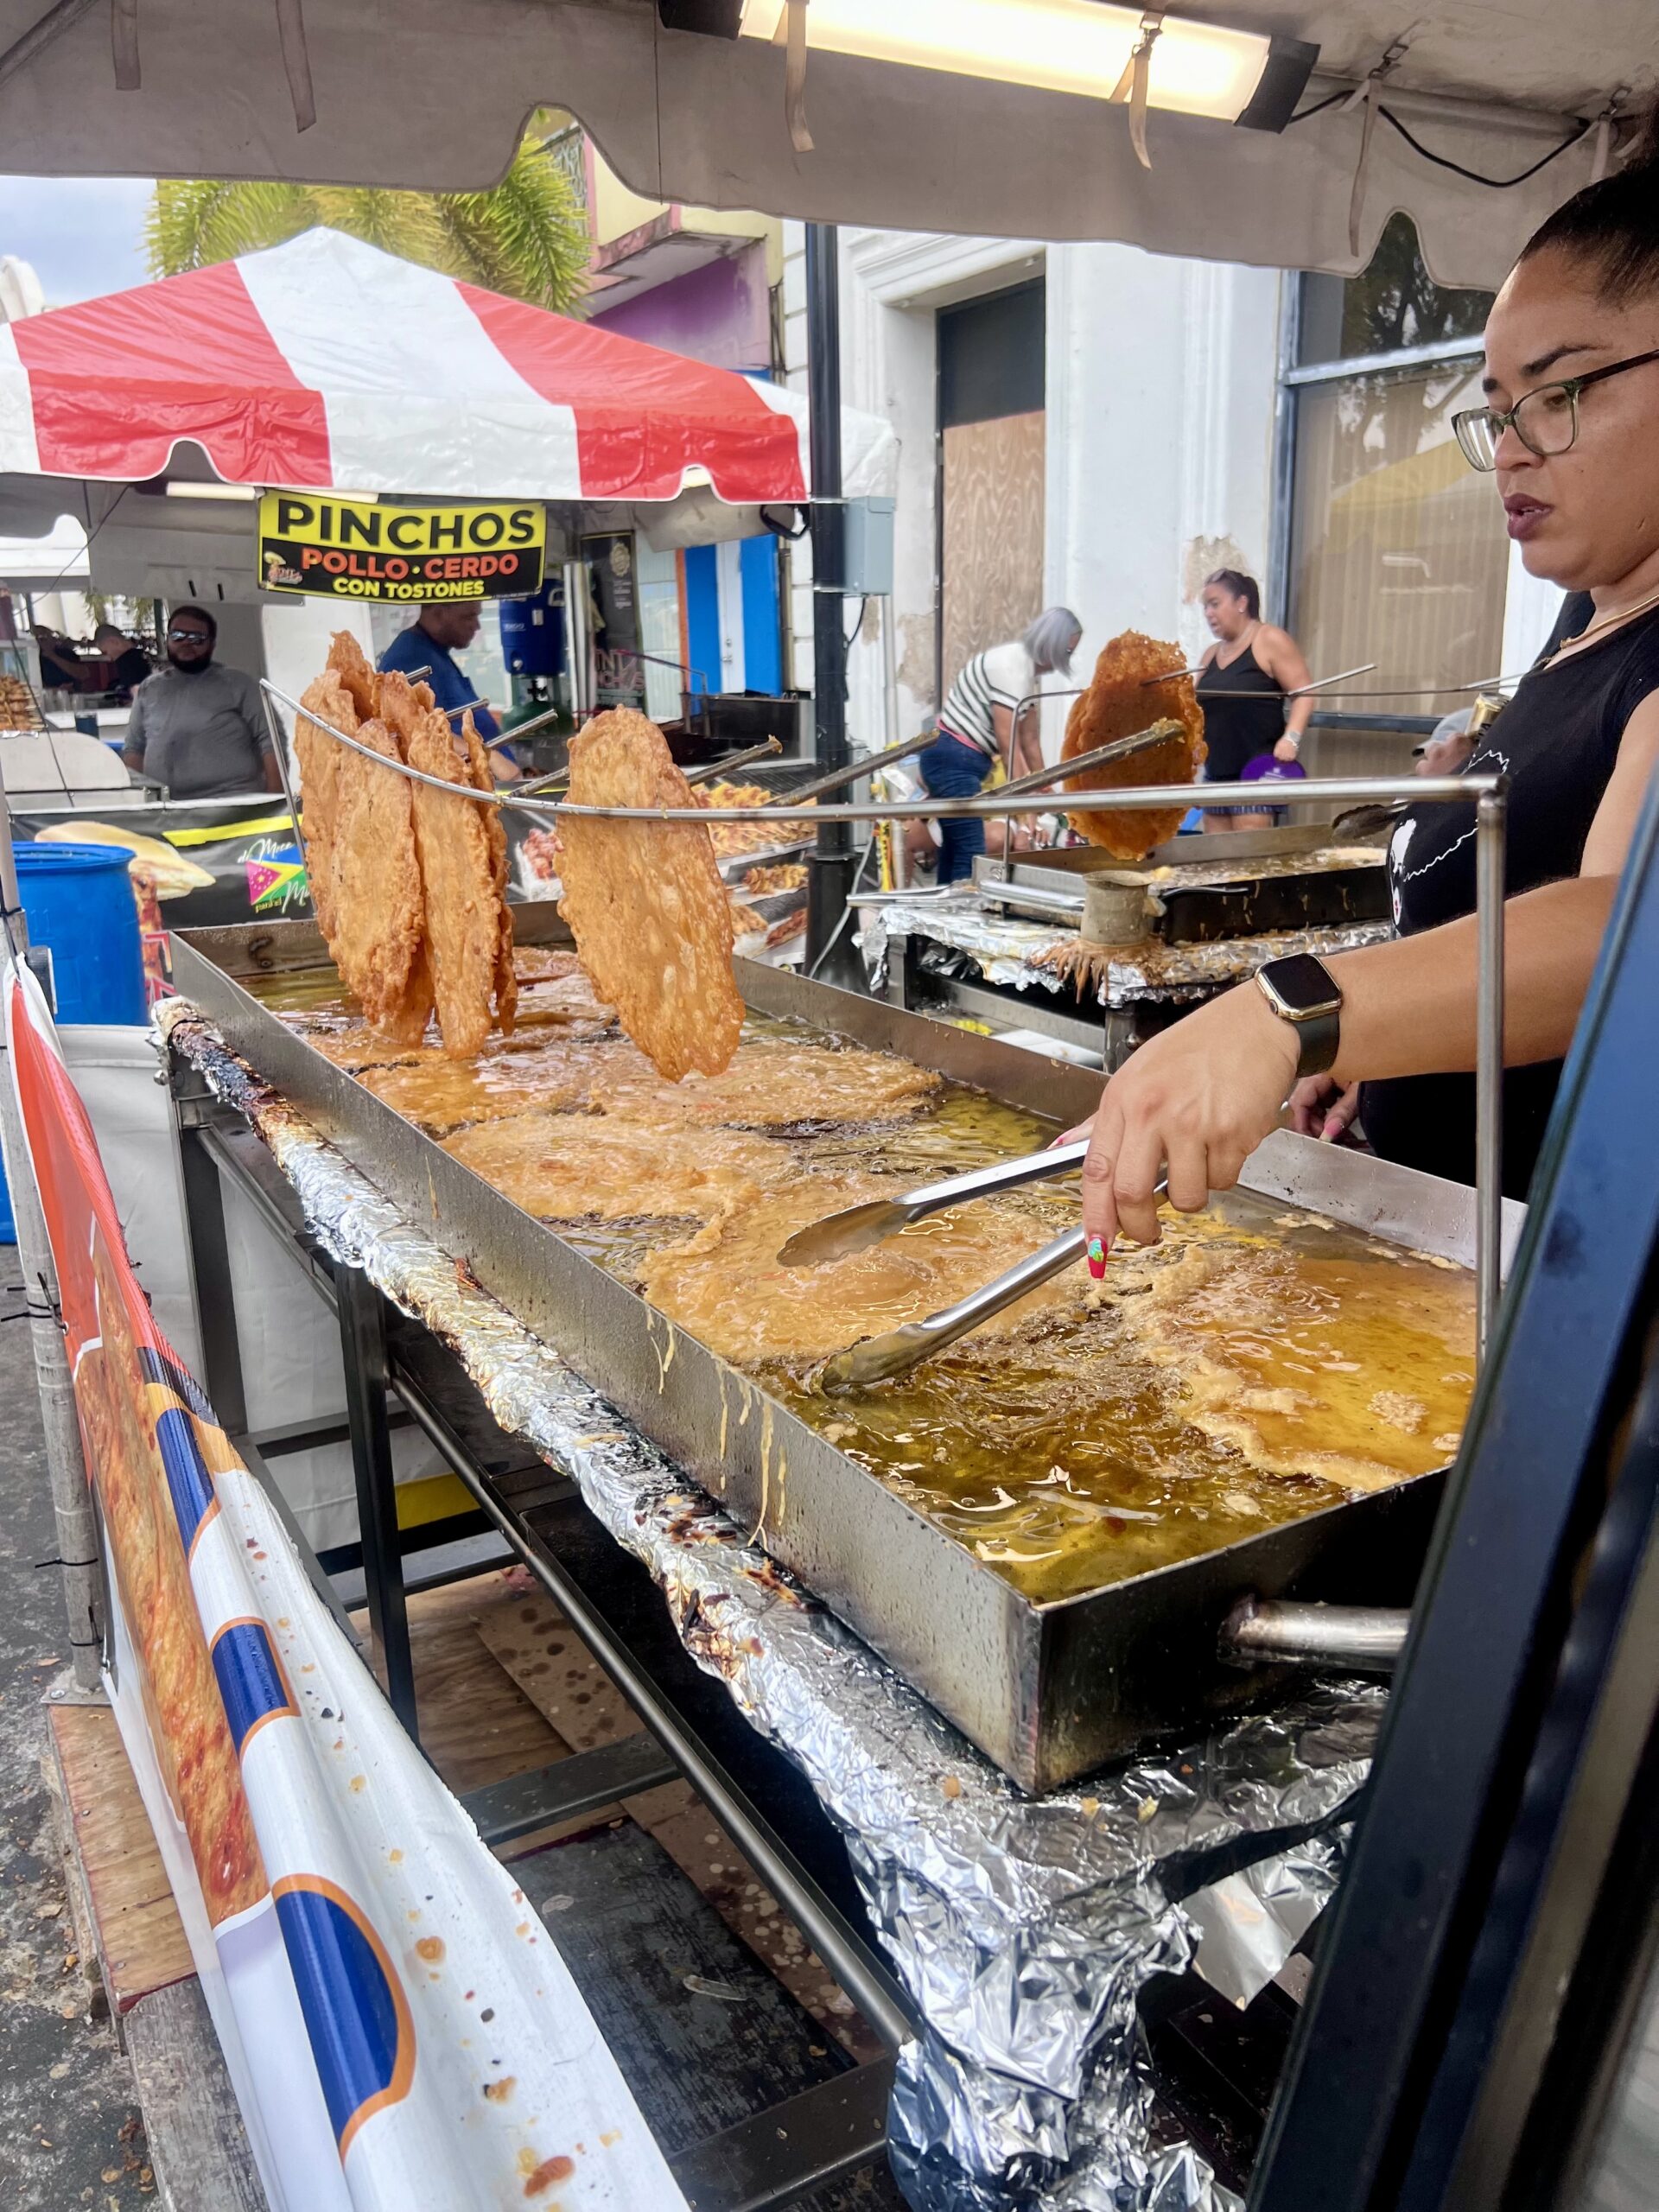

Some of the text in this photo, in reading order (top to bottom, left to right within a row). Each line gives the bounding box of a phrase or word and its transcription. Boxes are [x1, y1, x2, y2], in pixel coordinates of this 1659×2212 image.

[277, 499, 535, 550] PINCHOS
[302, 547, 409, 580] POLLO
[423, 554, 519, 580] CERDO
[333, 576, 485, 599] CON TOSTONES
